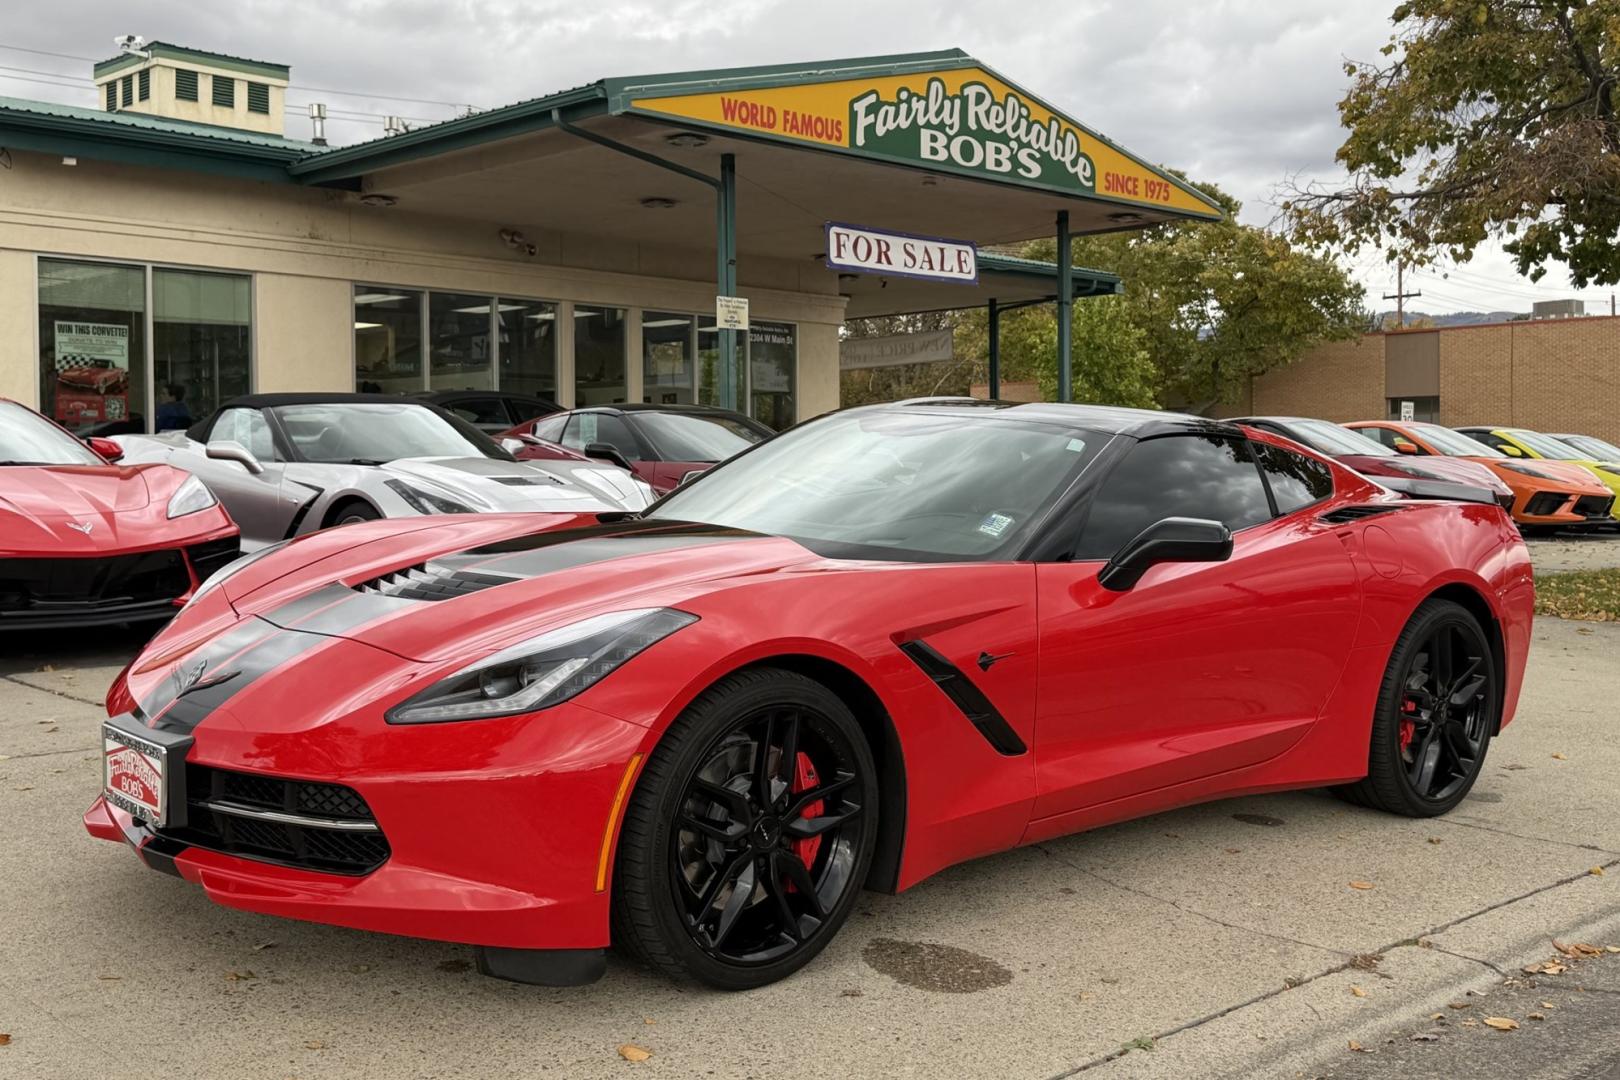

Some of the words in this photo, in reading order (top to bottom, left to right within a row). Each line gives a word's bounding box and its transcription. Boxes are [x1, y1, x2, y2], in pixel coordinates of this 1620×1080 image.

[720, 96, 777, 129] WORLD
[783, 110, 843, 142] FAMOUS
[853, 81, 961, 147] Fairly
[963, 84, 1094, 187] Reliable
[920, 128, 1042, 179] BOB'S
[1104, 171, 1139, 196] SINCE
[1143, 179, 1170, 201] 1975
[834, 231, 893, 266] FOR
[903, 242, 973, 275] SALE
[57, 323, 73, 334] WIN
[74, 324, 91, 335] THIS
[764, 334, 771, 343] W
[771, 334, 786, 344] Main
[121, 776, 144, 800] BOB'S
